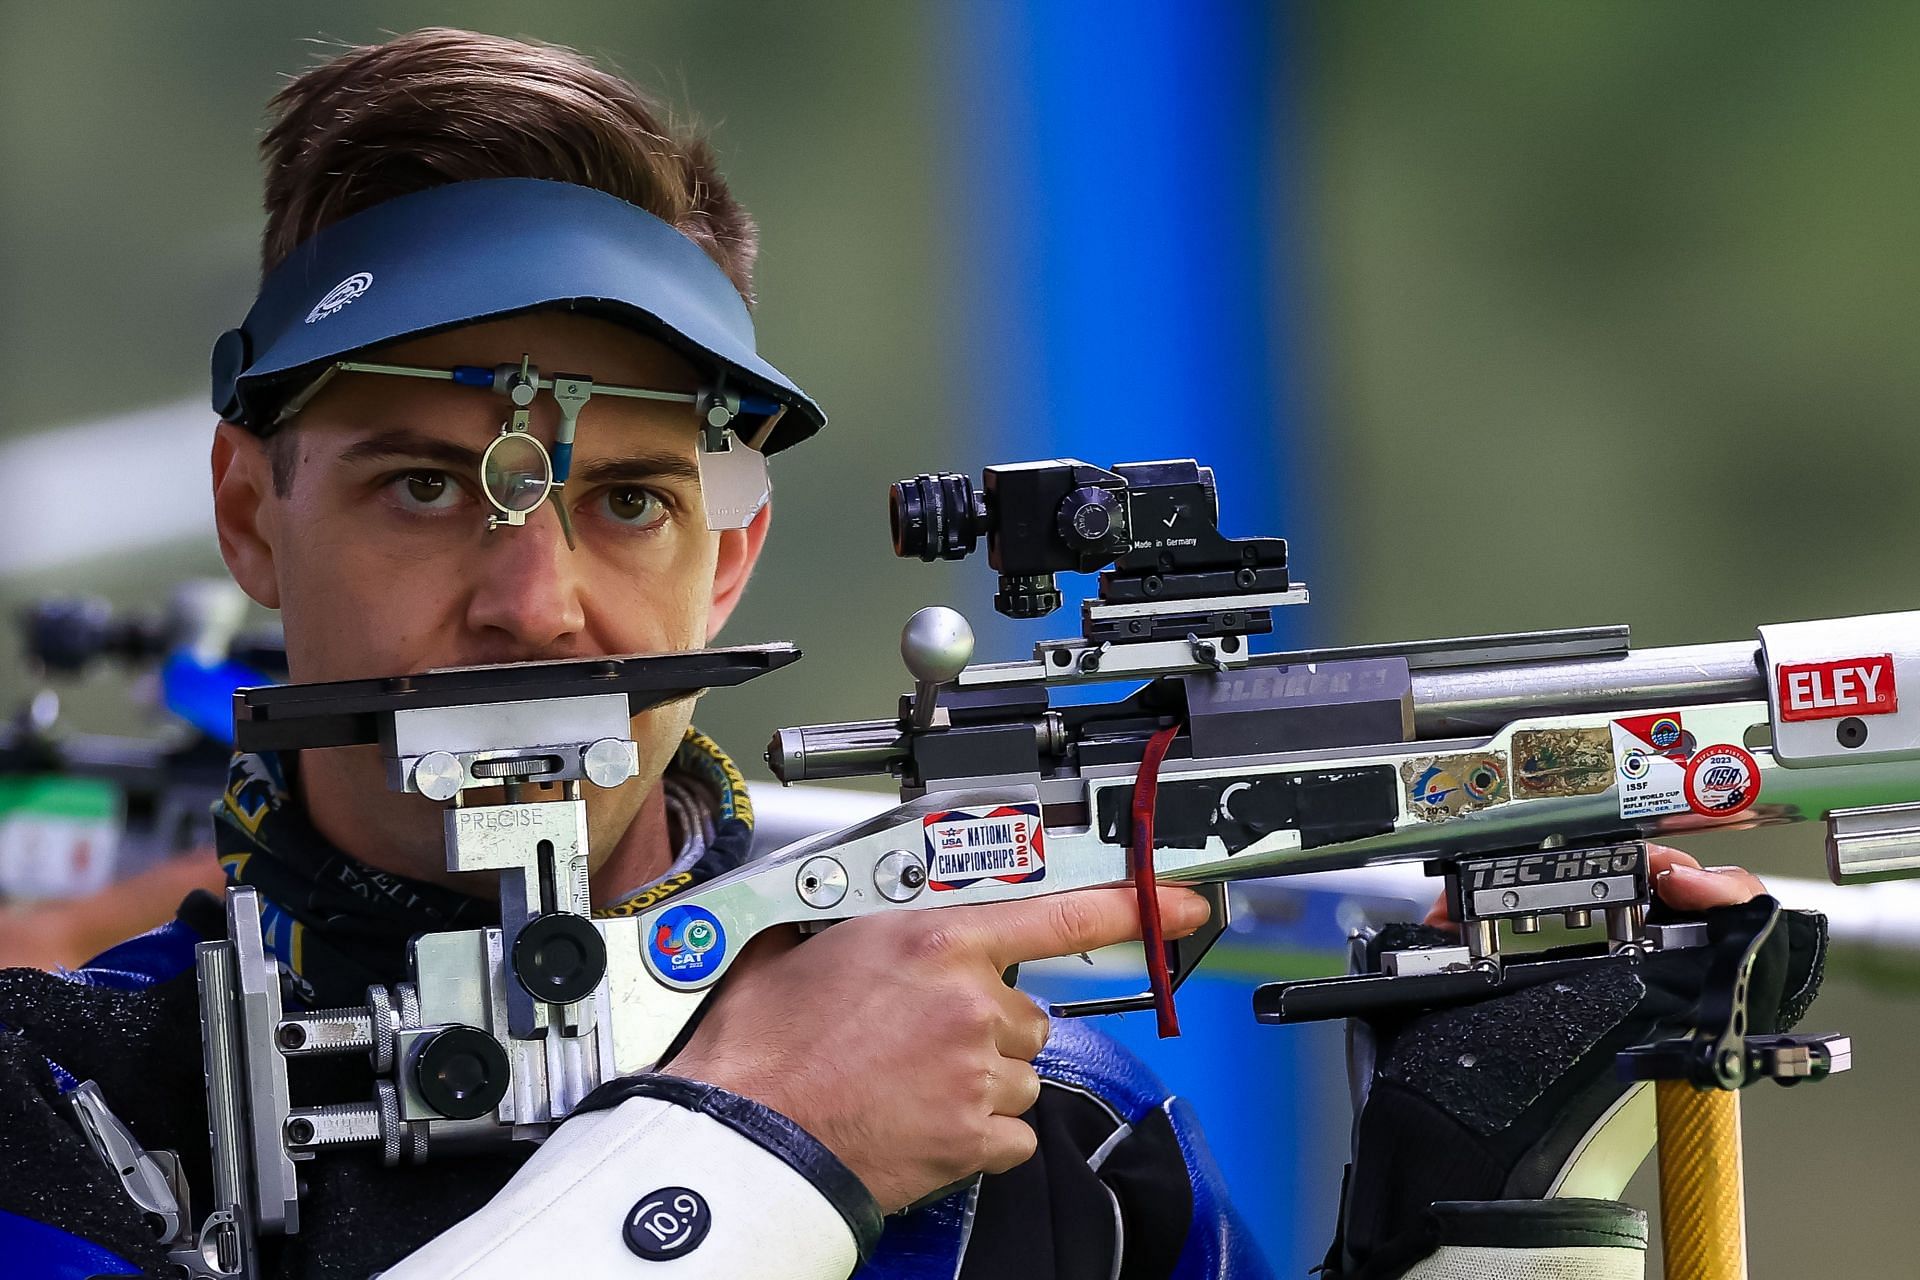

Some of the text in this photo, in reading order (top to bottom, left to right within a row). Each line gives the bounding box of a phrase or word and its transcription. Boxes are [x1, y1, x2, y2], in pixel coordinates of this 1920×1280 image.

[1134, 540, 1152, 549] Made
[1166, 538, 1197, 547] Germany
[1788, 665, 1882, 711] ELEY
[1710, 756, 1732, 764] 2023
[1708, 768, 1740, 786] USA
[1627, 782, 1648, 792] ISSF
[1640, 792, 1664, 800] WORLD
[460, 808, 543, 832] PRECISE
[942, 838, 962, 846] USA
[967, 824, 1012, 847] NATIONAL
[1014, 822, 1028, 866] 2022
[938, 849, 1015, 874] CHAMPIONSHIPS
[672, 952, 704, 964] CAT
[644, 1194, 698, 1242] 10.9
